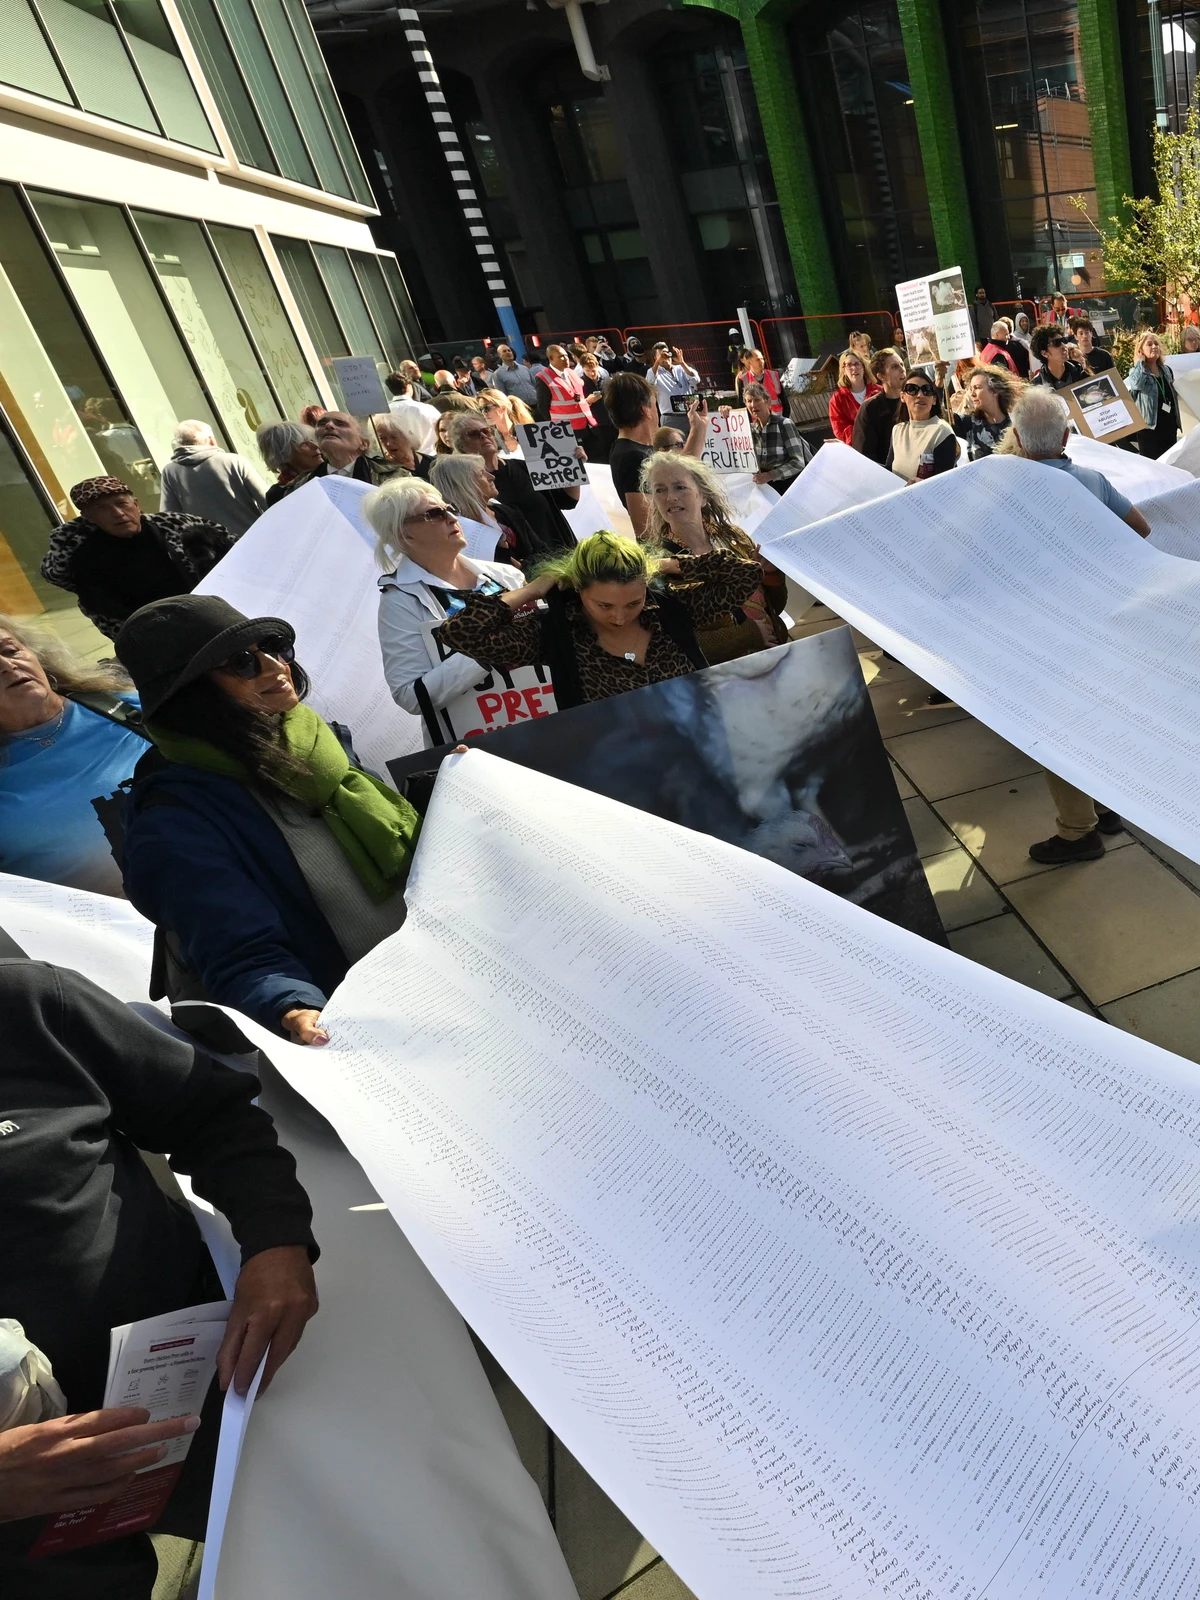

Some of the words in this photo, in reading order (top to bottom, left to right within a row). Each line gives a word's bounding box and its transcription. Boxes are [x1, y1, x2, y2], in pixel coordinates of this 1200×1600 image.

[711, 415, 744, 434] STOP
[705, 438, 714, 448] HE
[544, 456, 573, 470] DO
